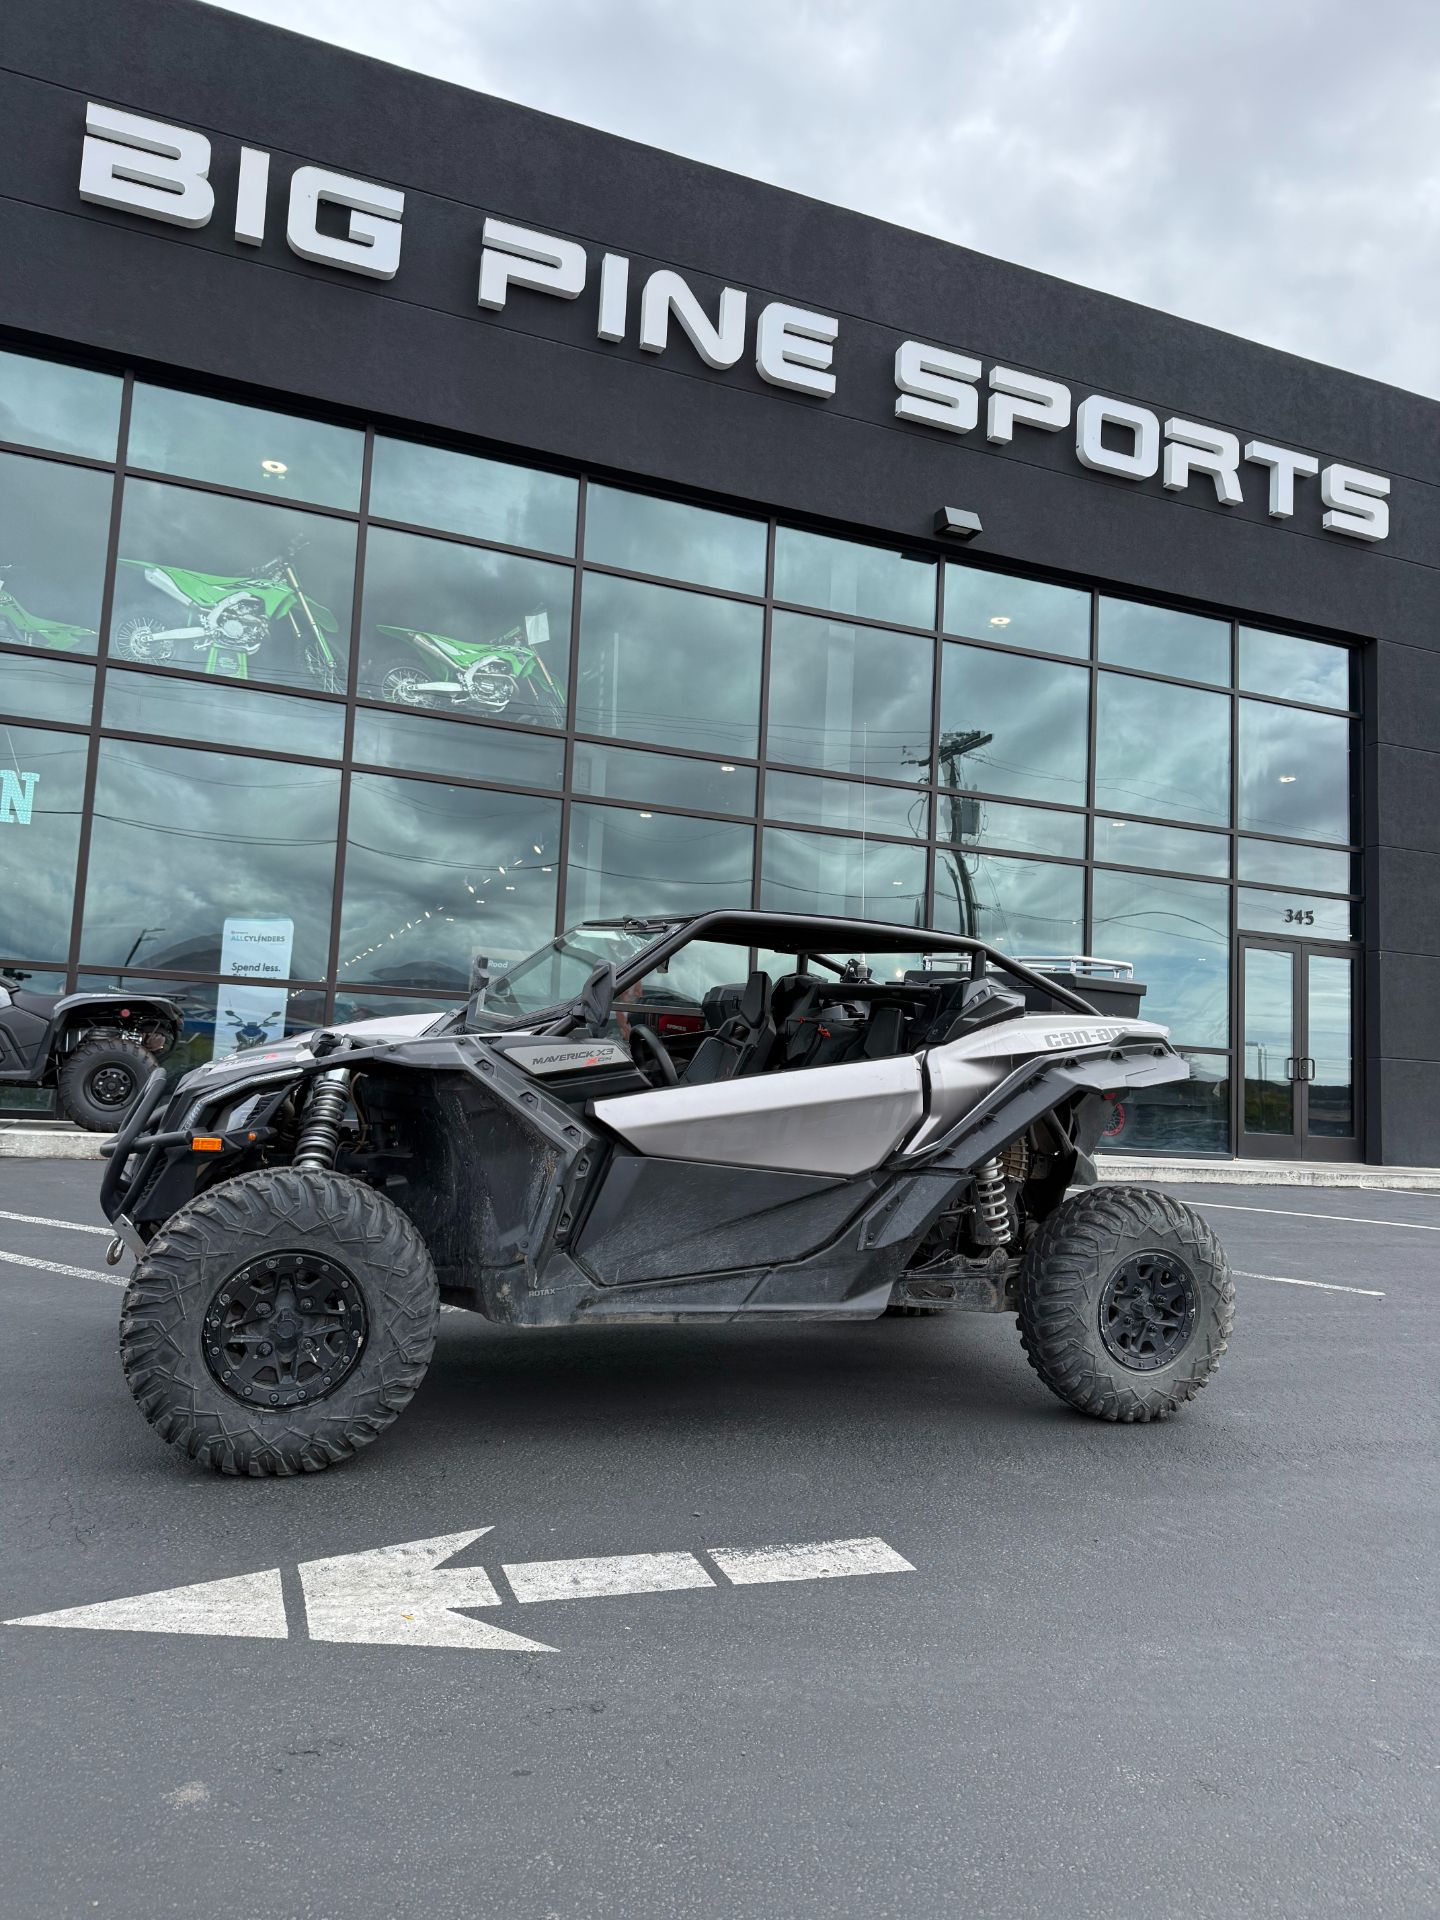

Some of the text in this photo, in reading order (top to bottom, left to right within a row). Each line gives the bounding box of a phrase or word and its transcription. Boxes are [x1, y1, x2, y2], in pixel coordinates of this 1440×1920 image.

[79, 101, 1392, 542] BIG PINE SPORTS
[1284, 909, 1314, 925] 345
[231, 962, 281, 973] Spend less.
[532, 1047, 615, 1065] MAVERICK X3
[528, 1288, 556, 1297] ROTAX
